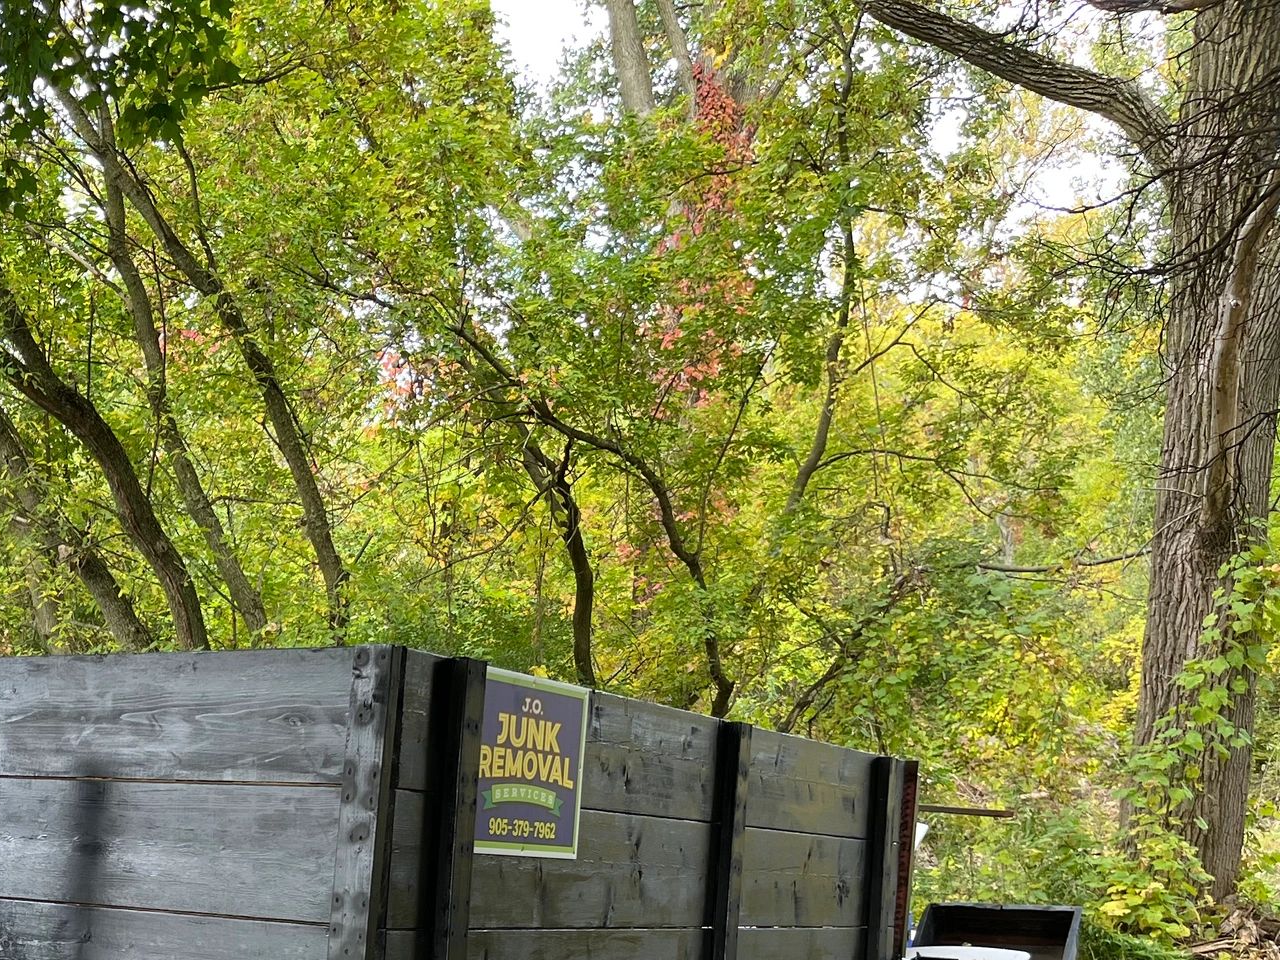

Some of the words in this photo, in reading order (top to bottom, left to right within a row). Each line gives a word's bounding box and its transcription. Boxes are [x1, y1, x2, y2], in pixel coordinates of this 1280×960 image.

[521, 697, 544, 715] J.O.
[496, 712, 561, 754] JUNK
[478, 744, 574, 790] REMOVAL
[495, 788, 554, 805] SERVICES
[488, 817, 556, 840] 905-379-7962
